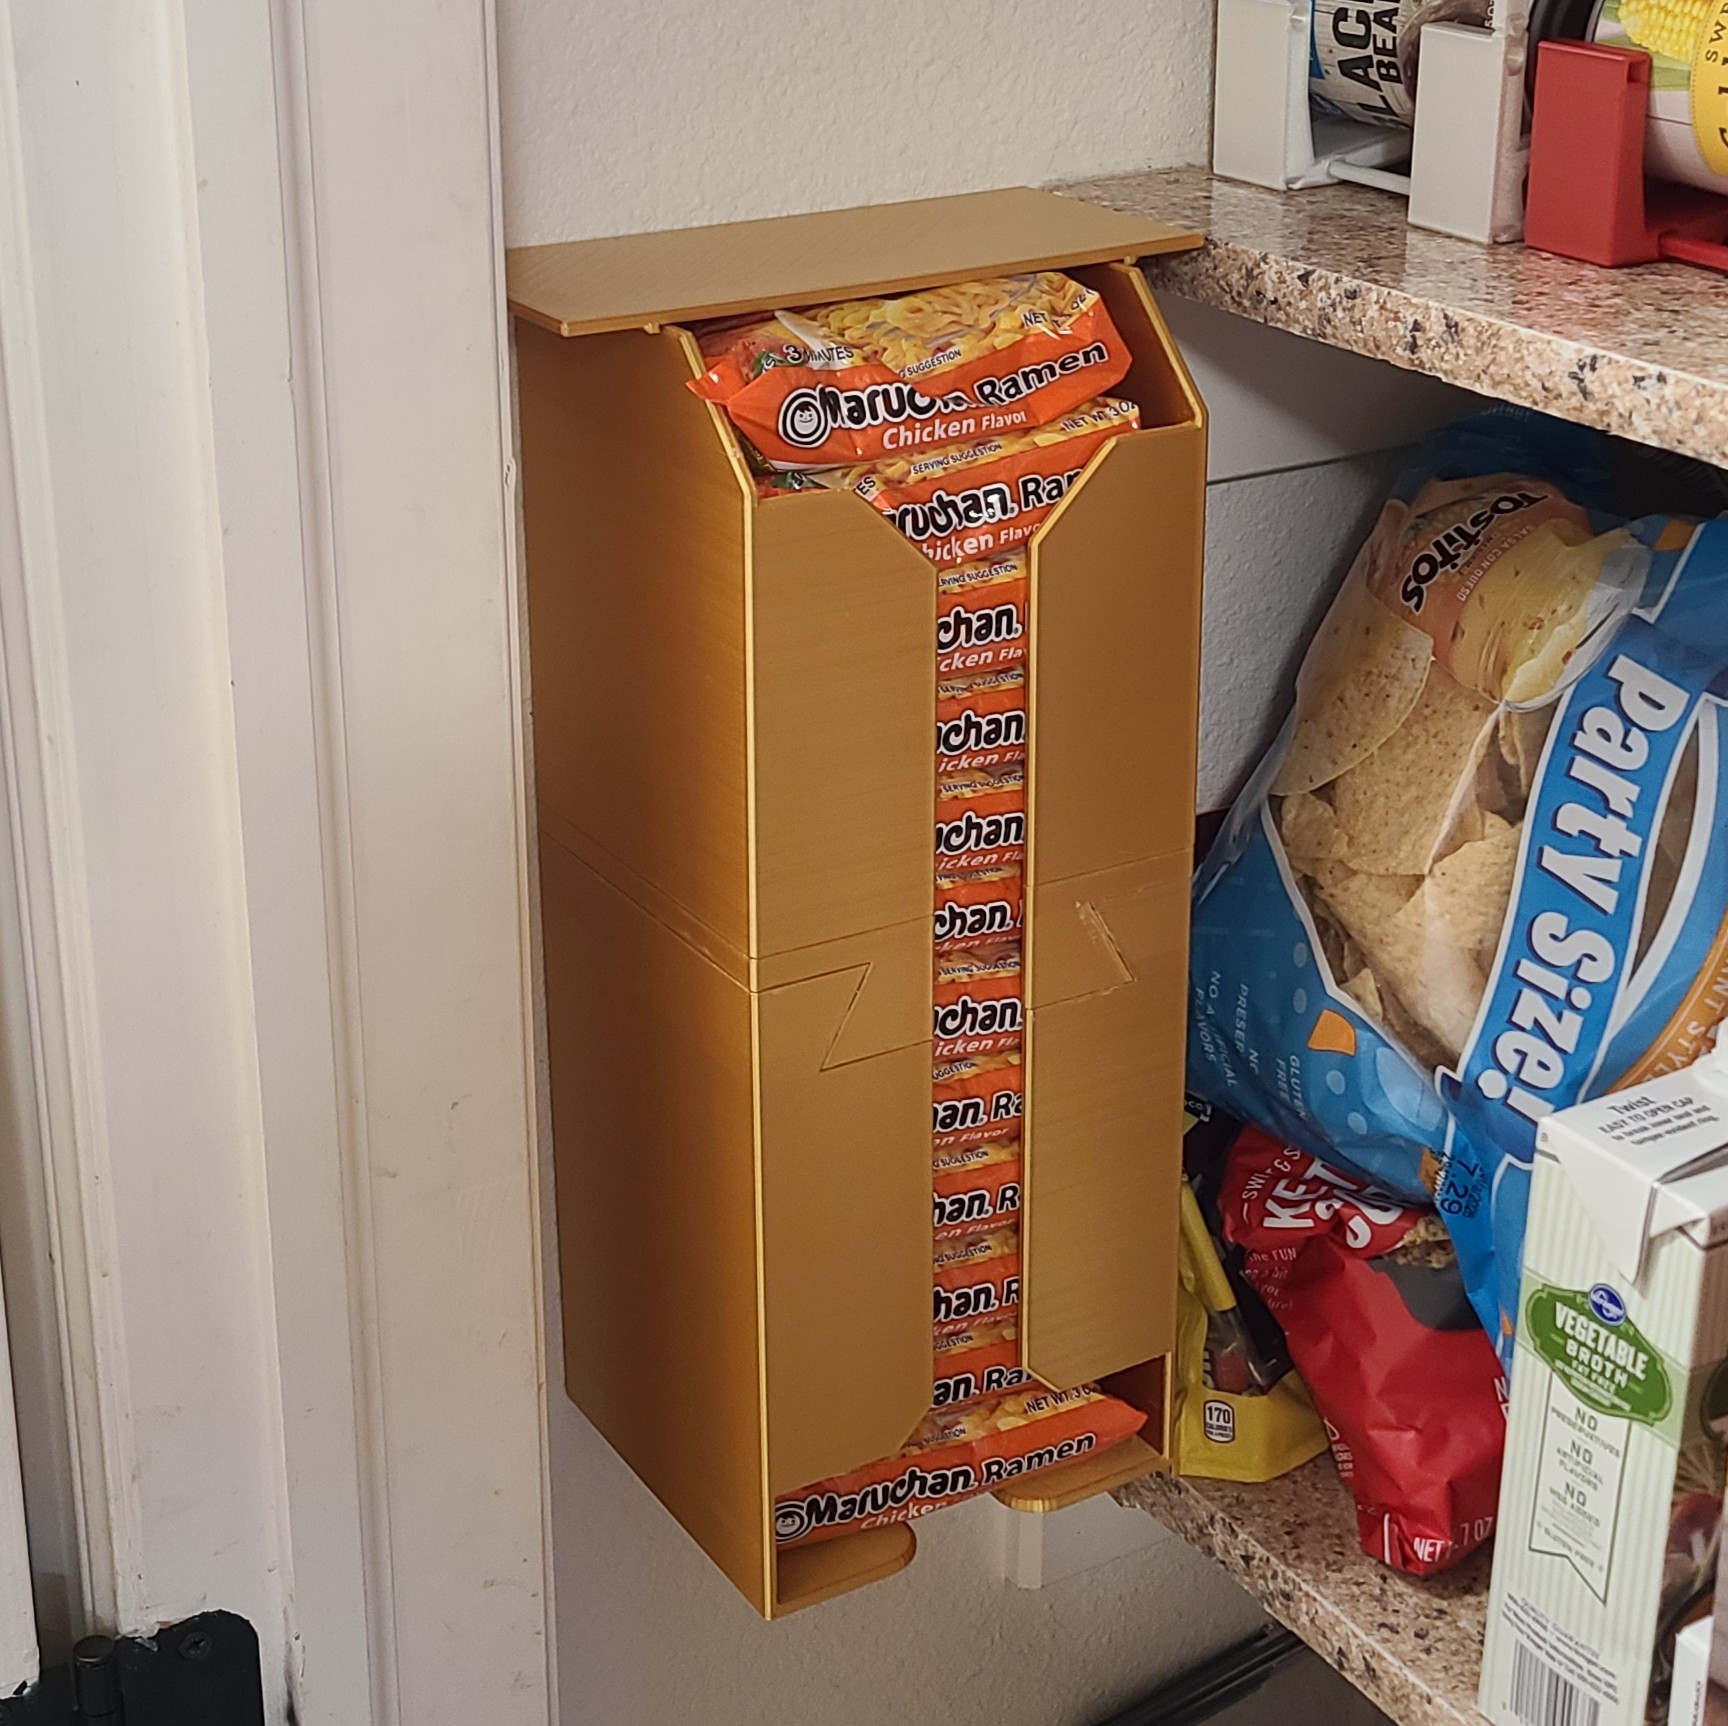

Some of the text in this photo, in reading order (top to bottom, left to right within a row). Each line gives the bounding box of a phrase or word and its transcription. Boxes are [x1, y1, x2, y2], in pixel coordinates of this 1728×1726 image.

[1373, 0, 1402, 85] BEA
[1332, 0, 1402, 118] LAC
[1023, 312, 1048, 328] NET
[784, 345, 802, 362] 3
[907, 349, 962, 376] SUGGESTION
[975, 343, 1108, 405] Ramen
[882, 415, 975, 449] Chicken
[912, 443, 1002, 475] SERVING SUGGESTION
[966, 563, 1018, 582] SUGGESTION
[1477, 653, 1691, 1121] Party Size!
[1208, 970, 1222, 999] NO
[1607, 1096, 1657, 1115] Twist
[1440, 1159, 1480, 1215] 7.29
[946, 1243, 992, 1263] SUGGESTION
[1555, 1301, 1649, 1381] VEGETABLE
[1566, 1338, 1629, 1389] BROTH
[1026, 1396, 1049, 1413] NET
[1207, 1405, 1231, 1424] 170
[1576, 1406, 1598, 1431] NO
[1570, 1439, 1593, 1465] NO
[806, 1433, 1095, 1525] Maruchan Ramen
[1565, 1481, 1587, 1507] NO
[1413, 1537, 1445, 1563] NET
